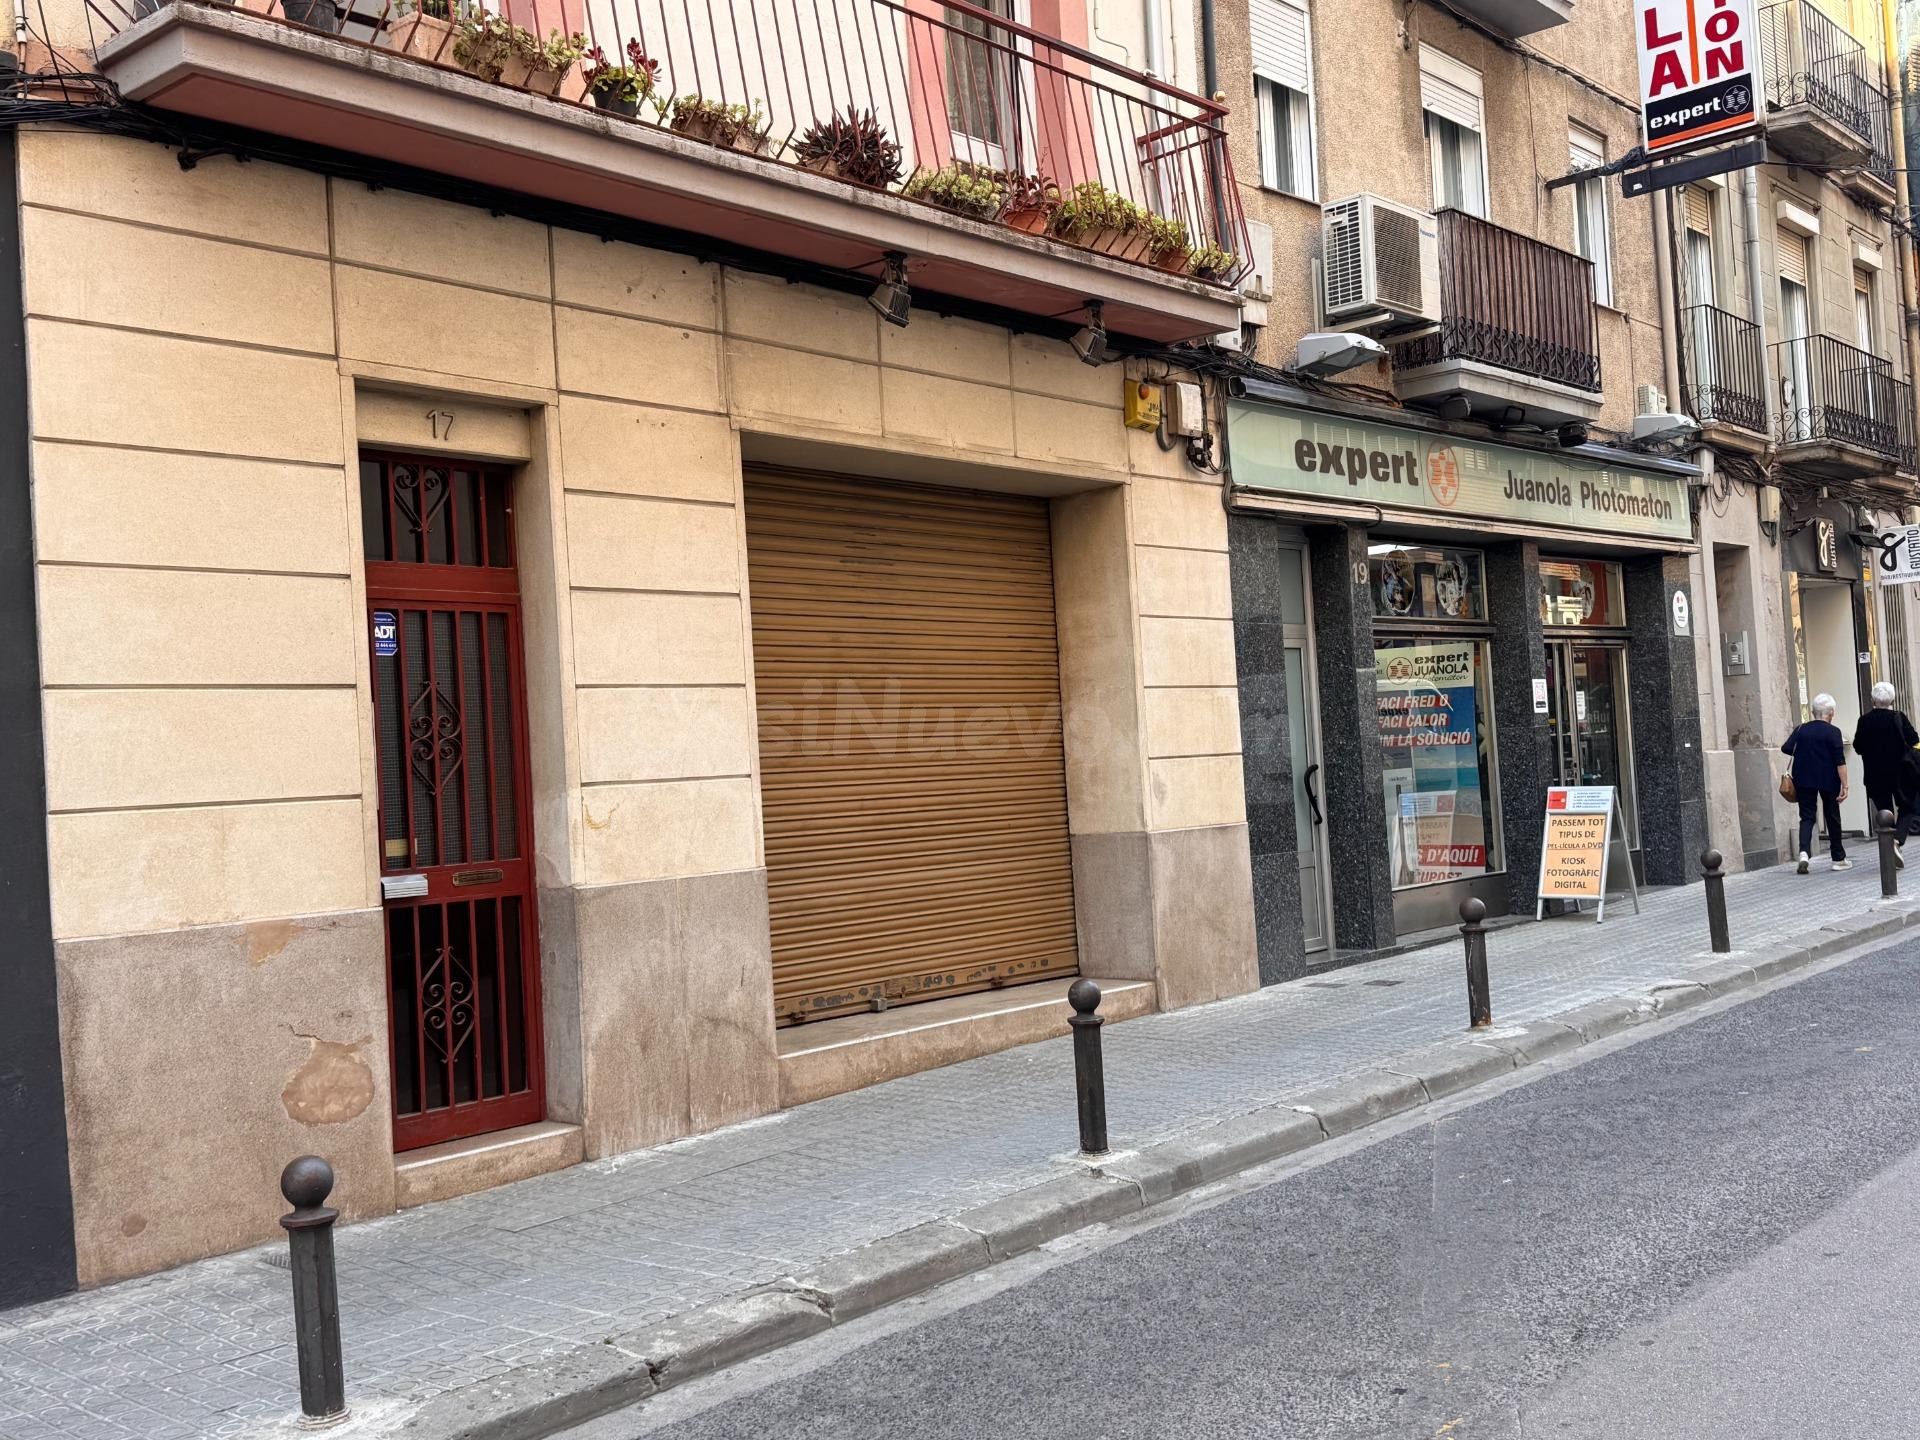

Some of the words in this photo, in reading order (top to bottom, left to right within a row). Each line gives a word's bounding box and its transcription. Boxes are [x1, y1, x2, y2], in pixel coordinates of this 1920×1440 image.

[1650, 97, 1722, 130] expert
[426, 408, 455, 441] 17
[1294, 438, 1419, 486] expert
[1504, 470, 1571, 506] Juanola
[1580, 481, 1673, 520] Photomaton
[1829, 523, 1837, 568] GUSTATIO
[1352, 563, 1368, 584] 19
[374, 625, 395, 638] ADT
[1415, 652, 1469, 665] expert
[1414, 663, 1469, 676] JUANOLA
[1404, 695, 1436, 708] FRED
[1406, 713, 1448, 728] CALOR
[1398, 734, 1413, 746] LA
[1417, 728, 1471, 746] SOLUCIÓ
[1551, 819, 1586, 827] PASSEM
[1588, 818, 1605, 826] TOT
[1558, 831, 1582, 839] TIPUS
[1584, 830, 1596, 838] DE
[1426, 846, 1479, 863] D'AQUÍ!
[1561, 857, 1586, 865] KIOSK
[1546, 867, 1600, 877] FOTOGRÀFIC
[1554, 881, 1587, 889] DIGITAL
